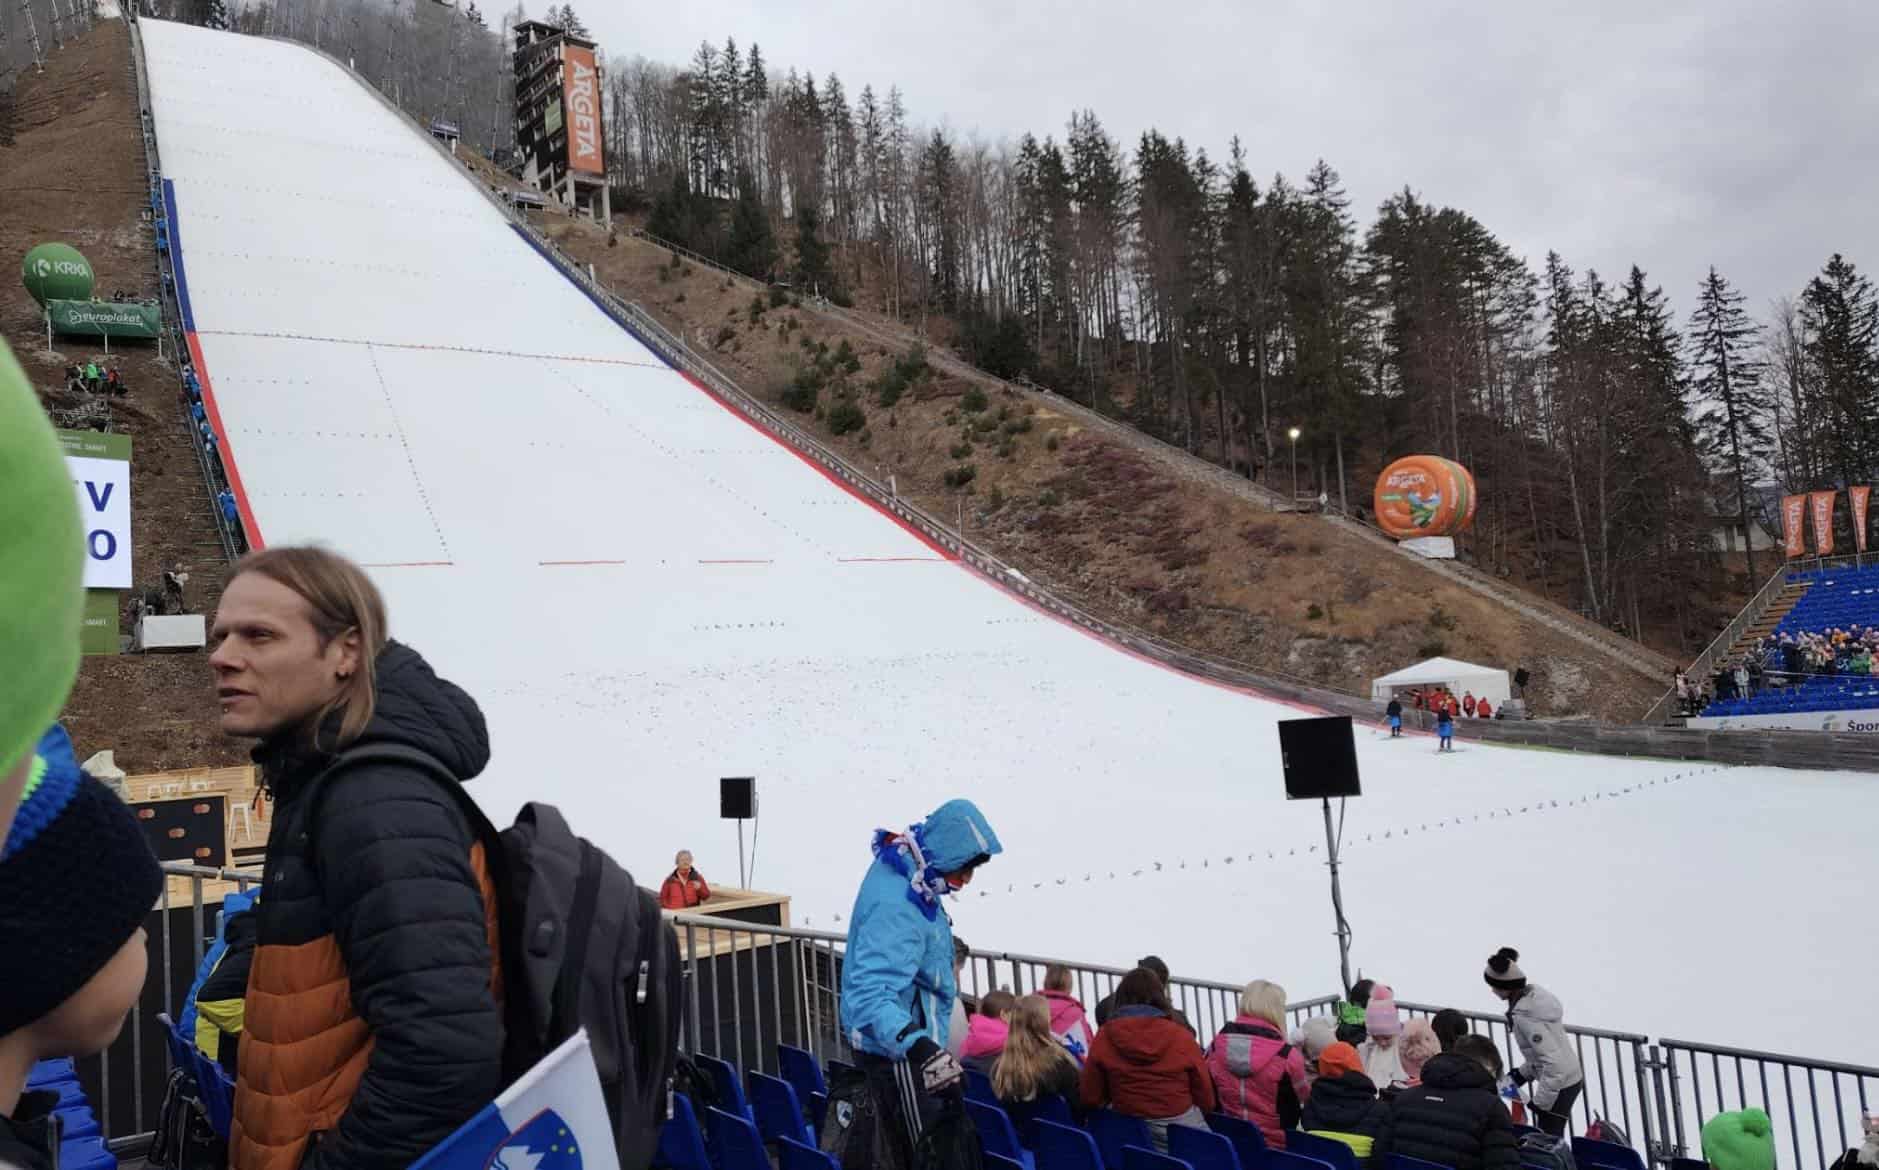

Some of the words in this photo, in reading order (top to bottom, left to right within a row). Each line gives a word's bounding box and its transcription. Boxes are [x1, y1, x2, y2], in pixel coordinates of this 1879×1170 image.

[569, 60, 596, 158] ARGETA
[82, 312, 141, 323] europlakat
[76, 480, 114, 512] V
